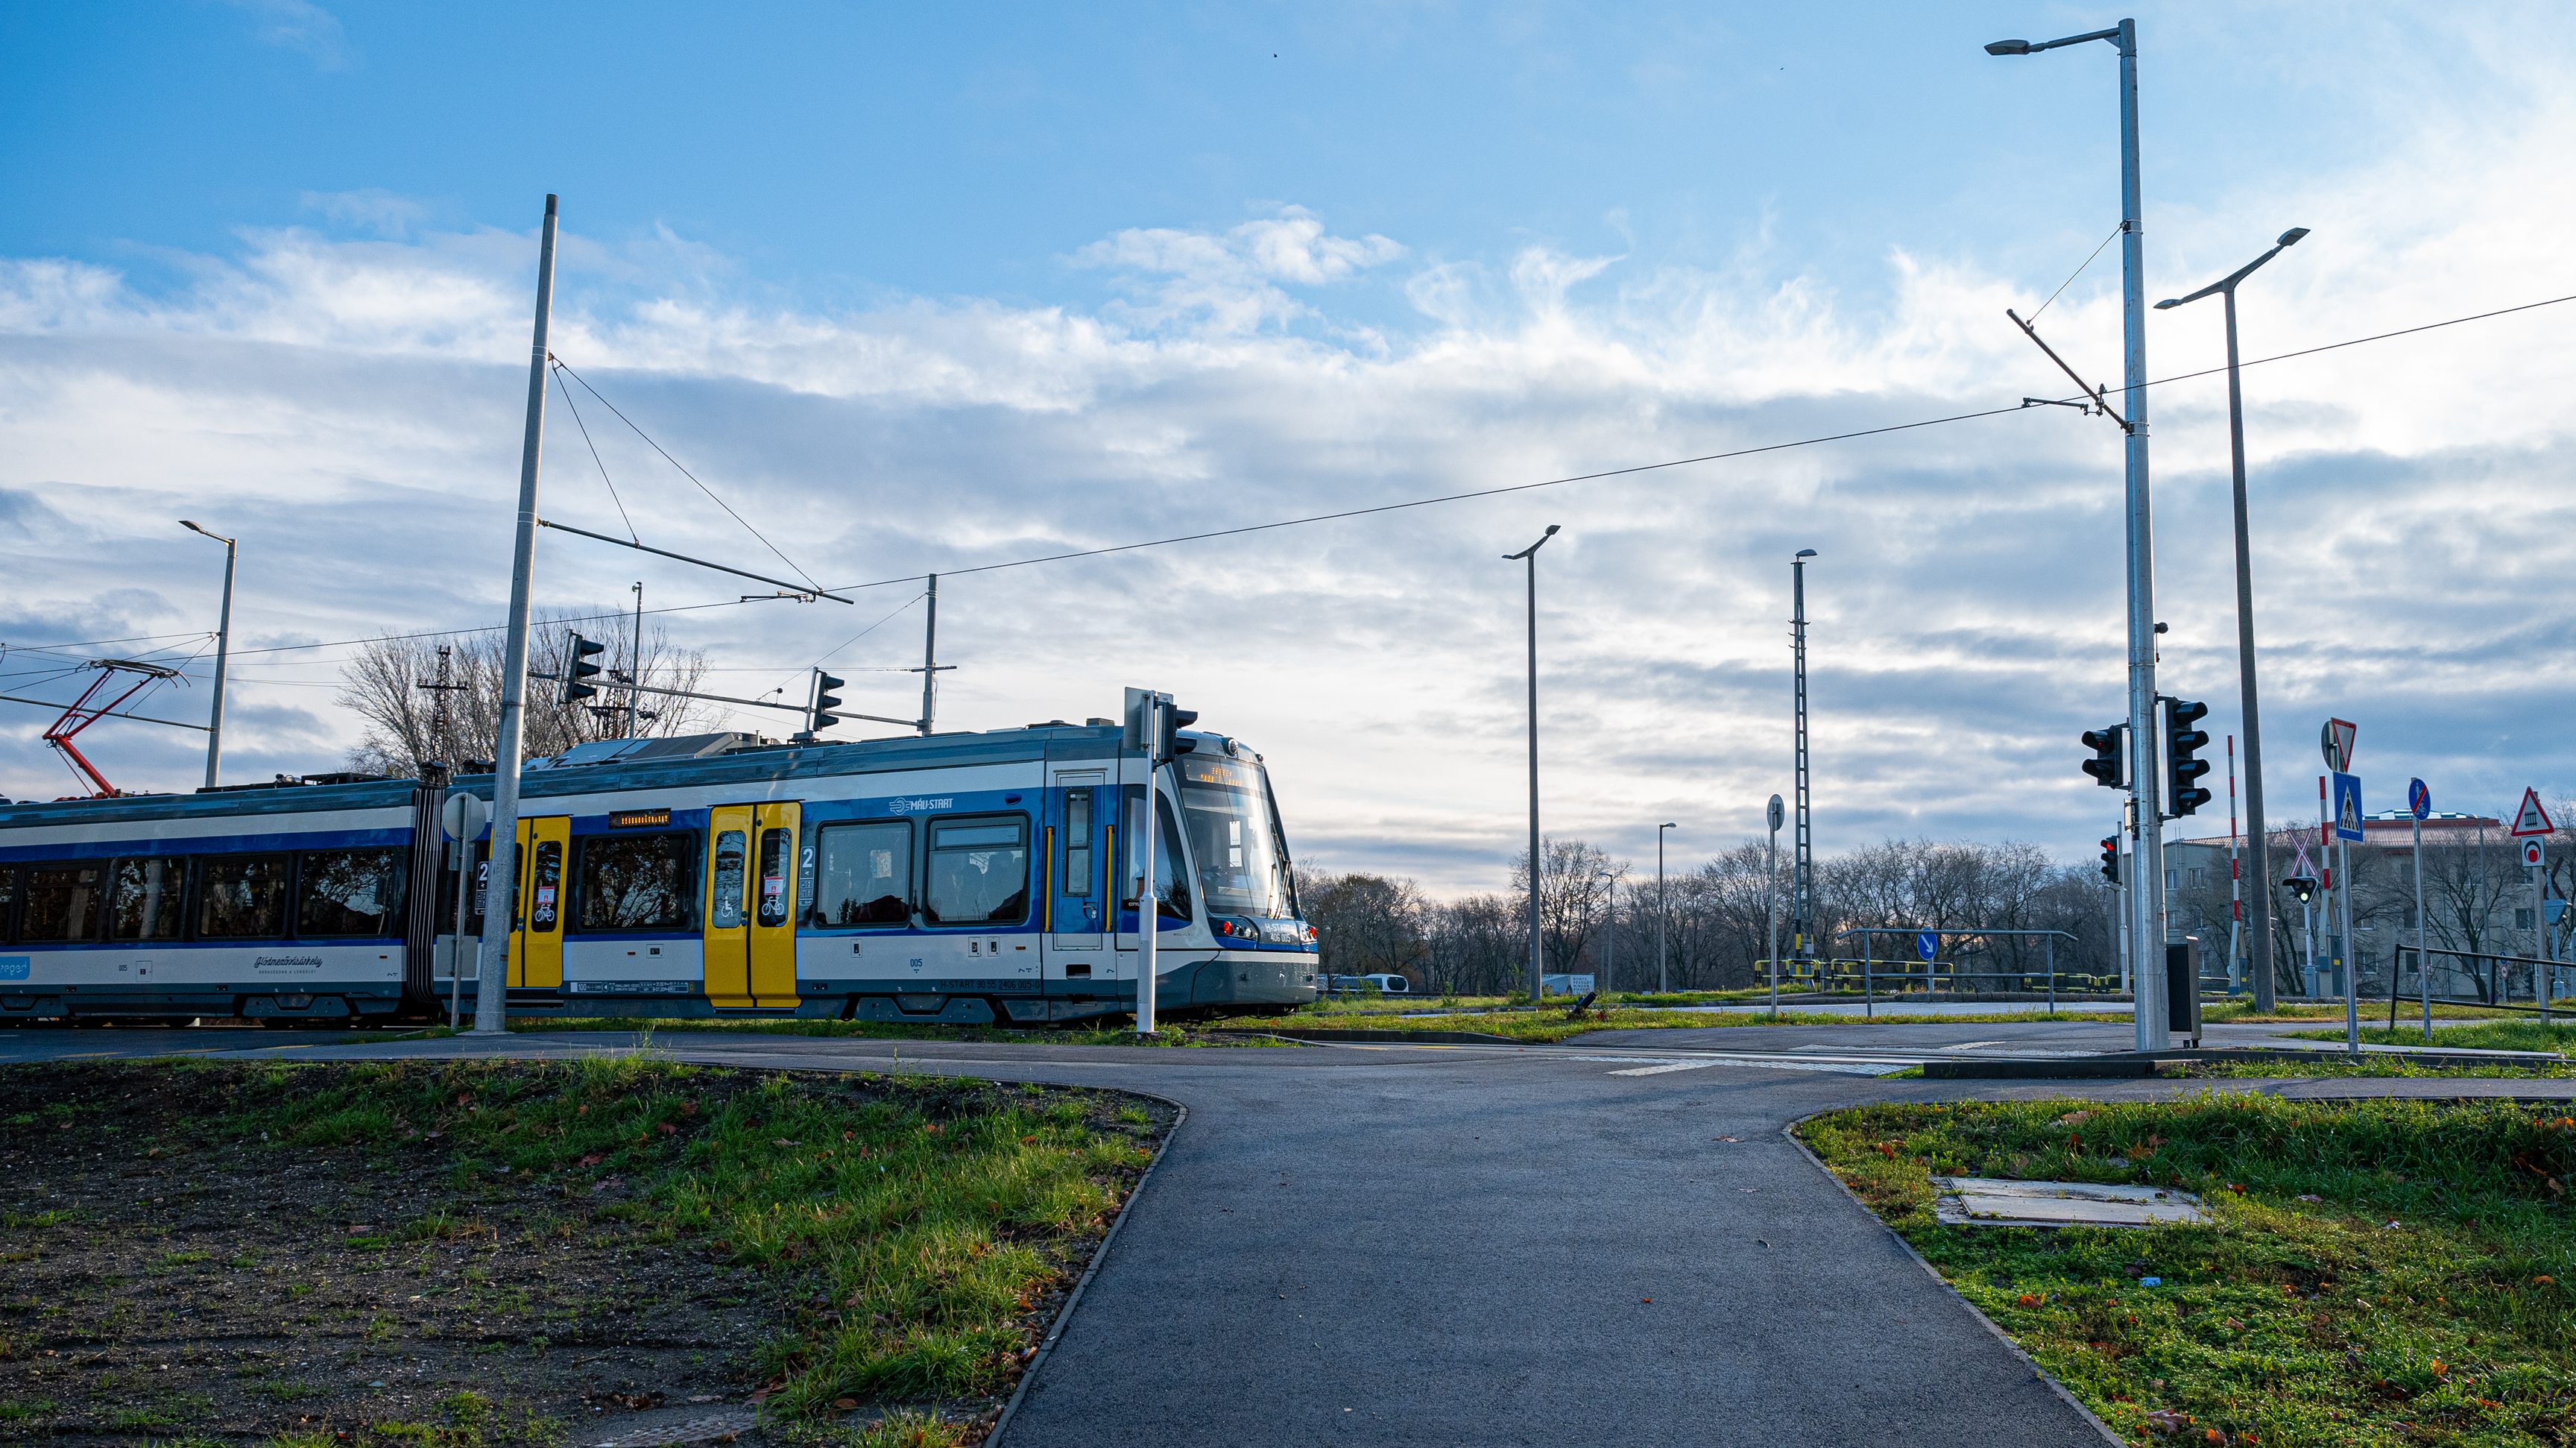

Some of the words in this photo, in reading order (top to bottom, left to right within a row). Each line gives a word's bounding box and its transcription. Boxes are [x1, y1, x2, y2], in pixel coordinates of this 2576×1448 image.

[911, 798, 953, 810] MÁV-START
[802, 848, 813, 868] 2
[479, 863, 488, 881] 2
[1265, 923, 1291, 932] H-START
[1270, 933, 1281, 942] 406
[1281, 934, 1291, 942] 005
[0, 960, 28, 976] zeged
[254, 956, 323, 969] Hódmezővásárhely
[910, 959, 923, 967] 005
[941, 980, 975, 989] H-START
[977, 980, 985, 989] 90
[987, 980, 996, 989] 55
[999, 980, 1016, 989] 2406
[1019, 980, 1040, 989] 005-0
